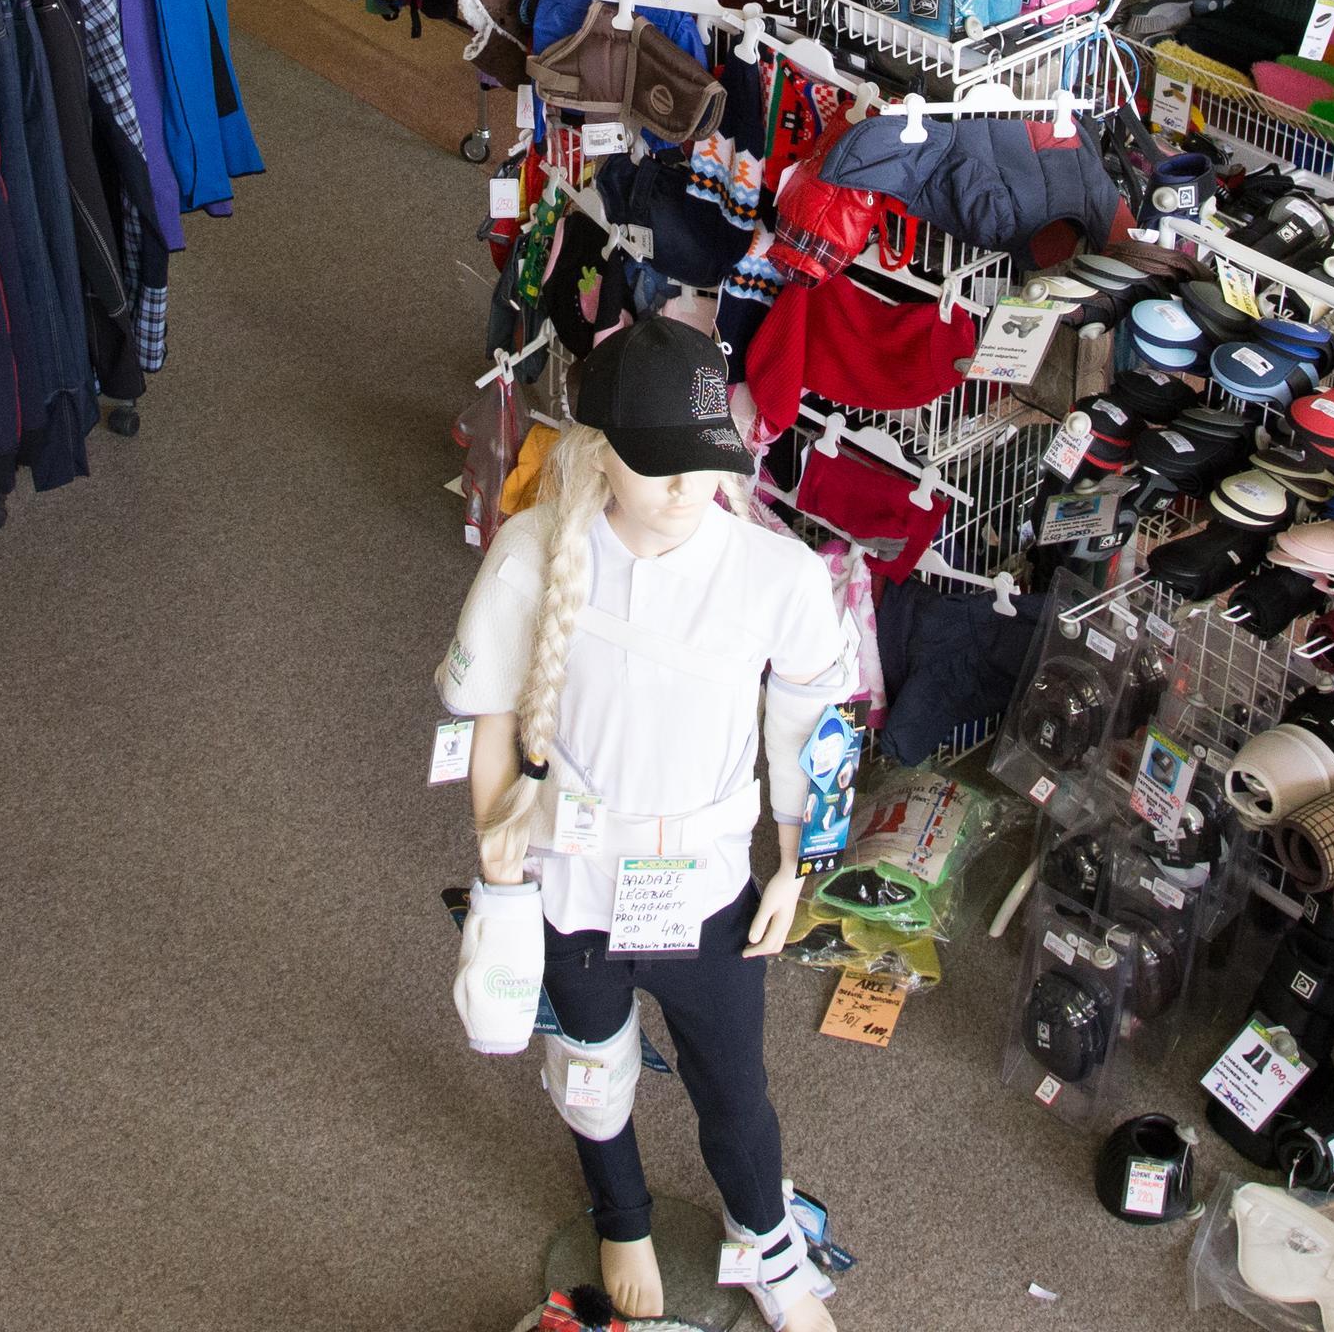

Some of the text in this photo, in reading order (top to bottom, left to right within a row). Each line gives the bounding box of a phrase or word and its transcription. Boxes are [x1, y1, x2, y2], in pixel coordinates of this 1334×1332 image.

[618, 900, 686, 913] S MAGNETY
[615, 913, 658, 923] PRO LIDI
[623, 924, 641, 934] OD
